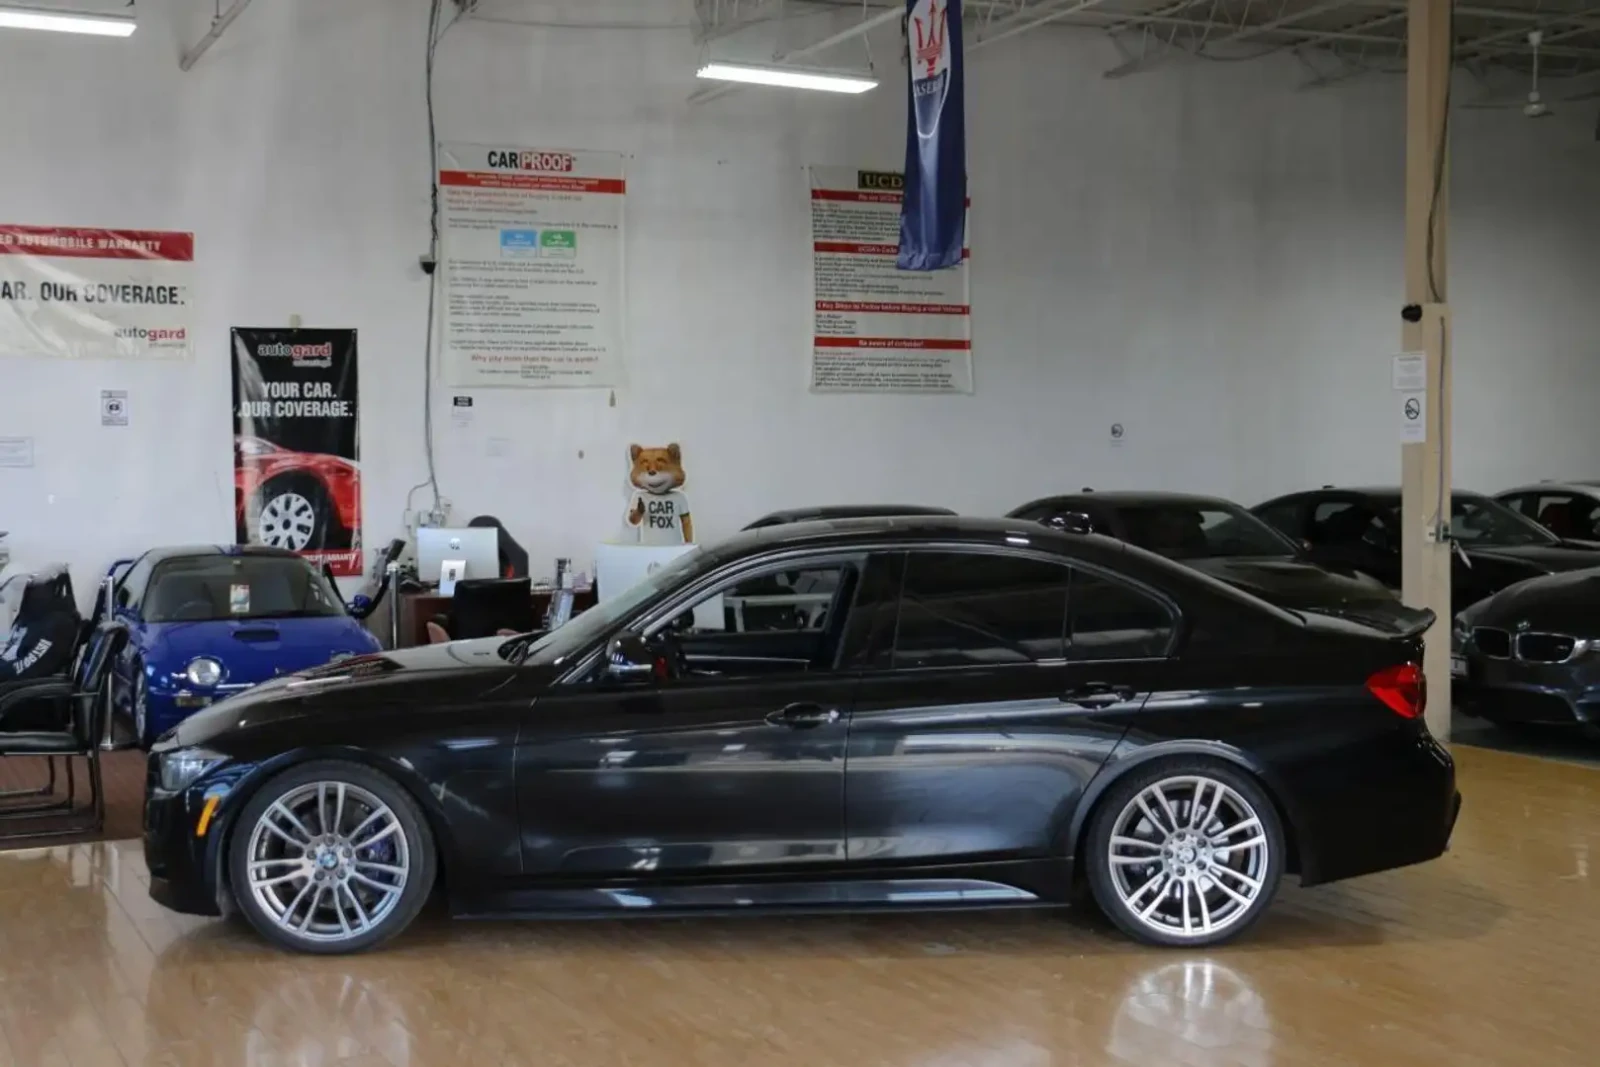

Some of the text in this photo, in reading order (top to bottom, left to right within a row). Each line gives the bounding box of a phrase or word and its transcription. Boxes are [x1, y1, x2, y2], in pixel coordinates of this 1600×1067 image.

[865, 175, 904, 188] UCD
[18, 235, 93, 248] AUTOMOBILE
[98, 238, 161, 251] WARRANTY
[40, 281, 77, 302] OUR
[84, 284, 185, 305] COVERAGE.
[114, 326, 185, 341] autogard
[258, 342, 332, 358] autogard
[262, 382, 337, 398] YOUR CAR.
[241, 401, 353, 417] OUR COVERAGE.
[648, 501, 674, 514] CAR
[649, 516, 674, 529] FOX
